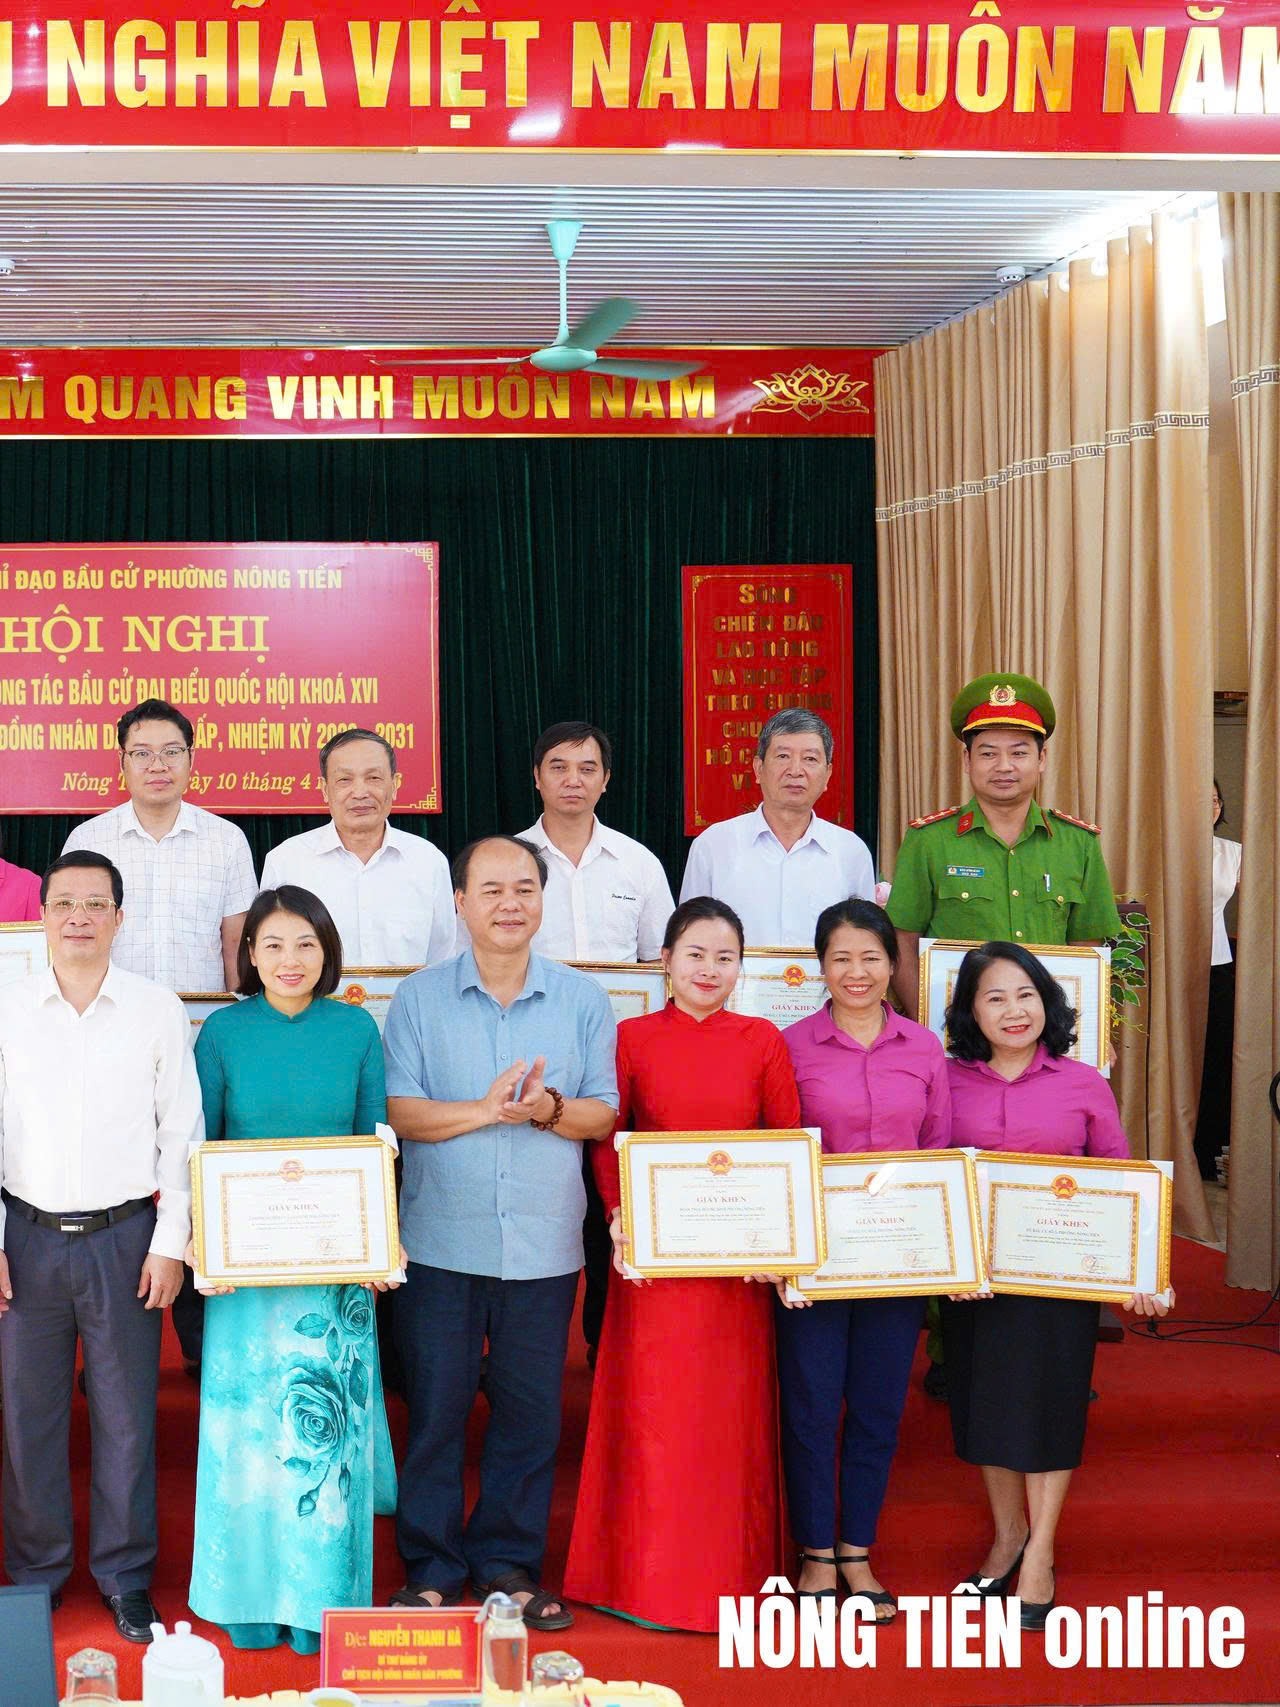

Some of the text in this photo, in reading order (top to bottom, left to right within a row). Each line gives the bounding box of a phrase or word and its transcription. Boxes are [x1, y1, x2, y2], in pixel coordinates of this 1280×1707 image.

[46, 0, 327, 108] NGHĨA
[347, 0, 540, 129] VIỆT
[571, 21, 782, 111] NAM
[810, 0, 1077, 114] MUÔN
[63, 375, 248, 424] QUANG
[266, 375, 394, 419] VINH
[14, 570, 57, 594] ĐẠO
[62, 563, 104, 590] BẦU
[110, 560, 141, 590] CỬ
[143, 564, 228, 590] PHƯỜNG
[233, 563, 291, 589] NÔNG
[296, 561, 343, 589] TIẾN
[0, 603, 270, 664] HỘI NGHỊ
[31, 673, 64, 706] TÁC
[68, 669, 104, 705] BẦU
[108, 666, 134, 705] CỬ
[170, 667, 210, 704] BIỂU
[214, 667, 261, 707] QUỐC
[266, 672, 295, 710] HỘI
[299, 672, 347, 704] KHOÁ
[350, 677, 379, 704] XVI
[49, 719, 98, 751] NHÂN
[228, 718, 285, 755] NHIỆM
[290, 716, 312, 749] KỲ
[61, 772, 113, 795] Nông
[217, 773, 238, 791] 10
[242, 772, 296, 795] tháng
[300, 773, 311, 790] 4
[411, 1628, 446, 1648] THANH
